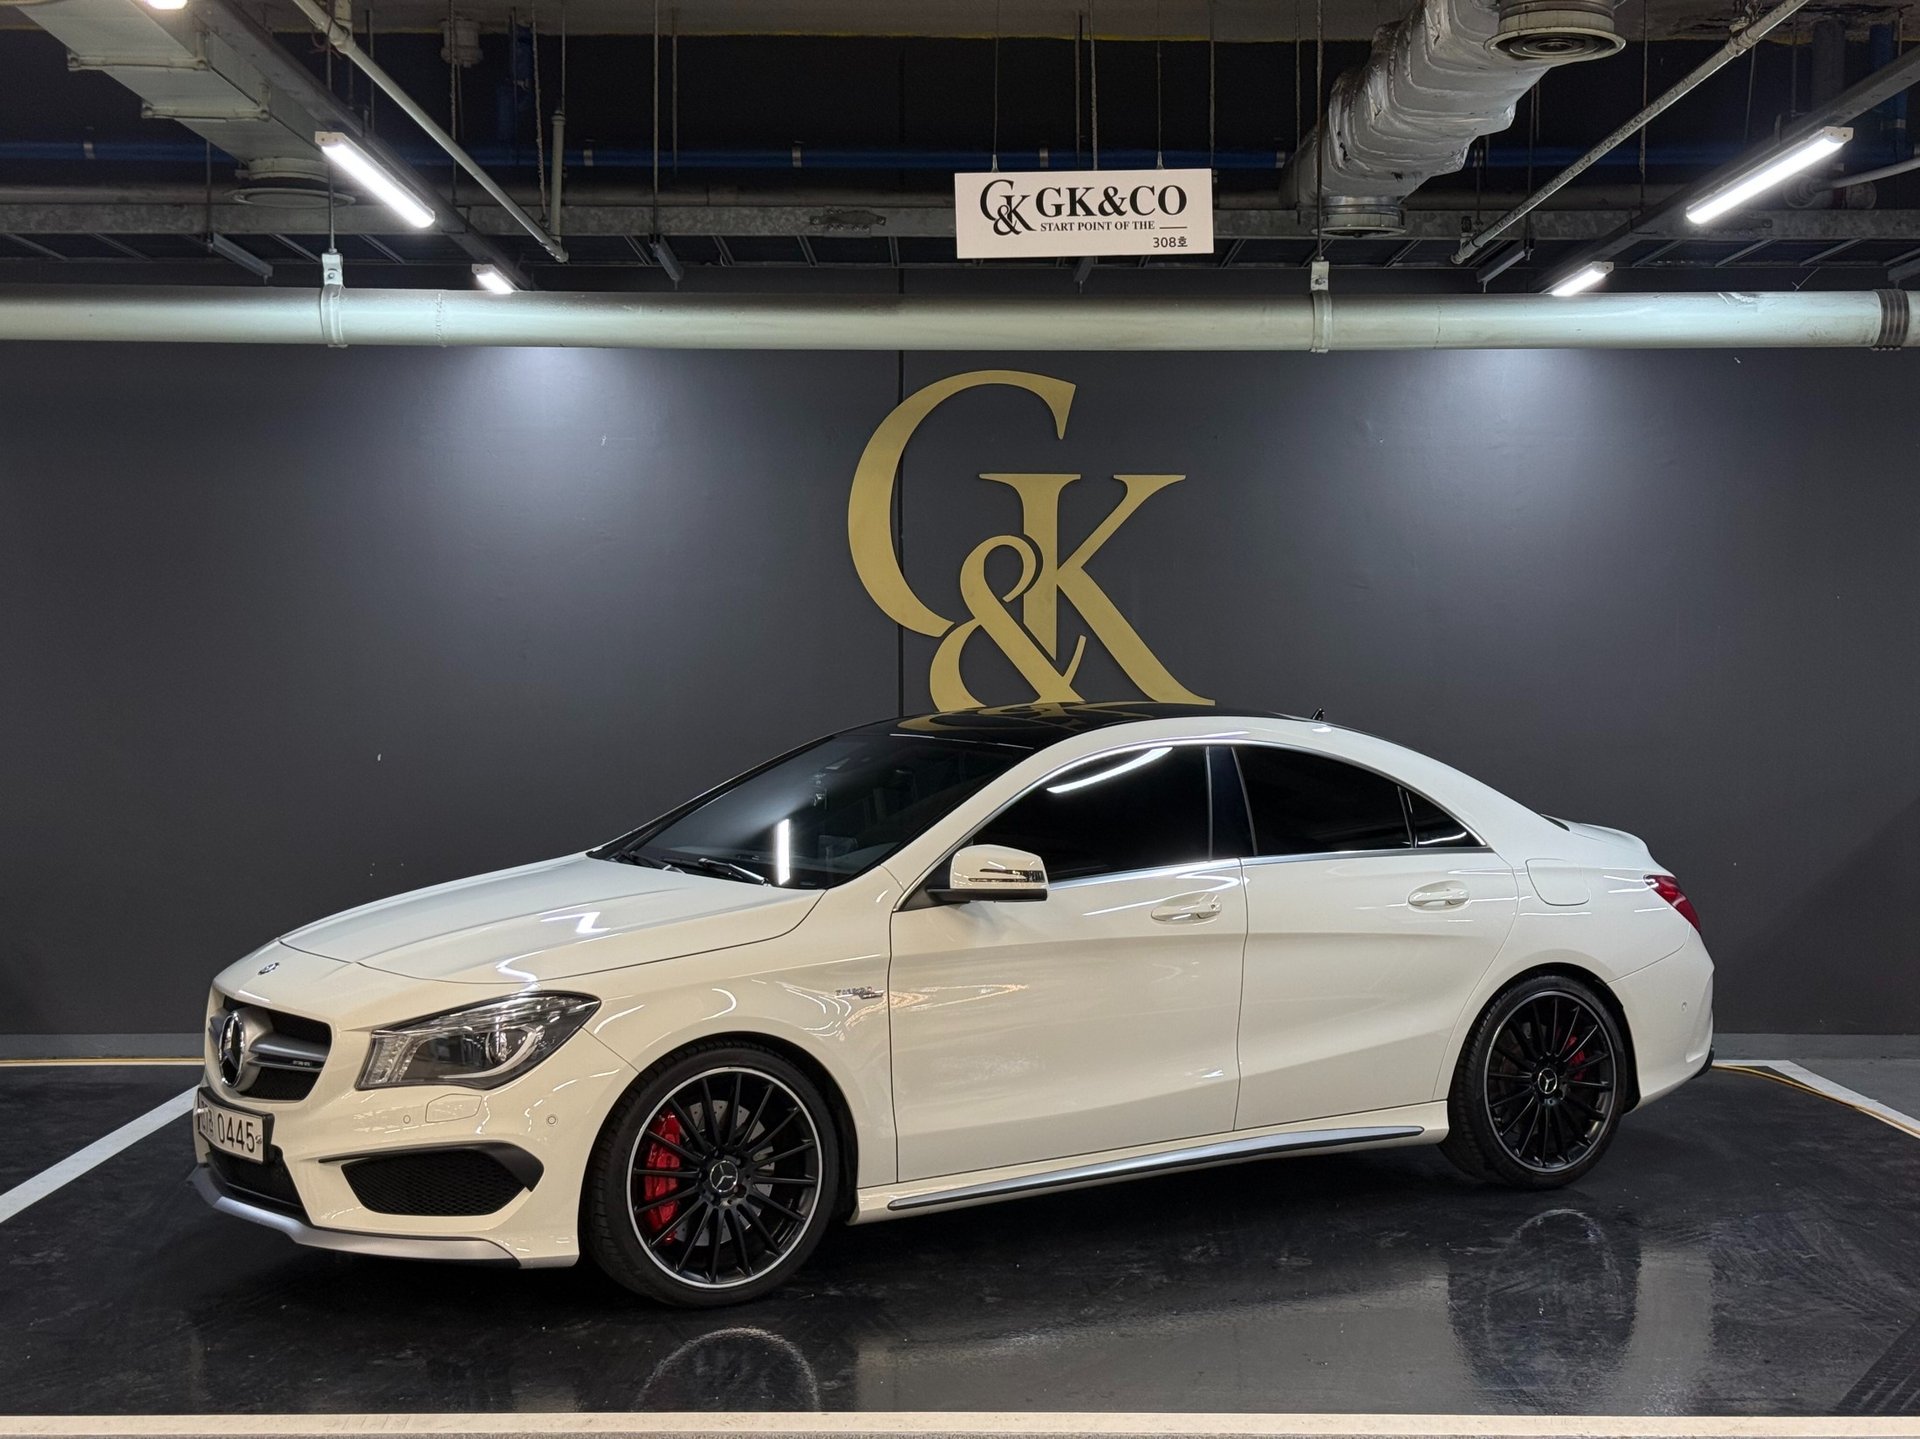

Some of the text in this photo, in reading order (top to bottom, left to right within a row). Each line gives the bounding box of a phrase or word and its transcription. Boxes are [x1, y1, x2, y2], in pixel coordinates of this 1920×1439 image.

[1035, 184, 1188, 218] GK&CO
[1040, 220, 1155, 232] START POINT OF THE
[1152, 236, 1188, 249] 308호
[217, 1112, 255, 1154] 0445
